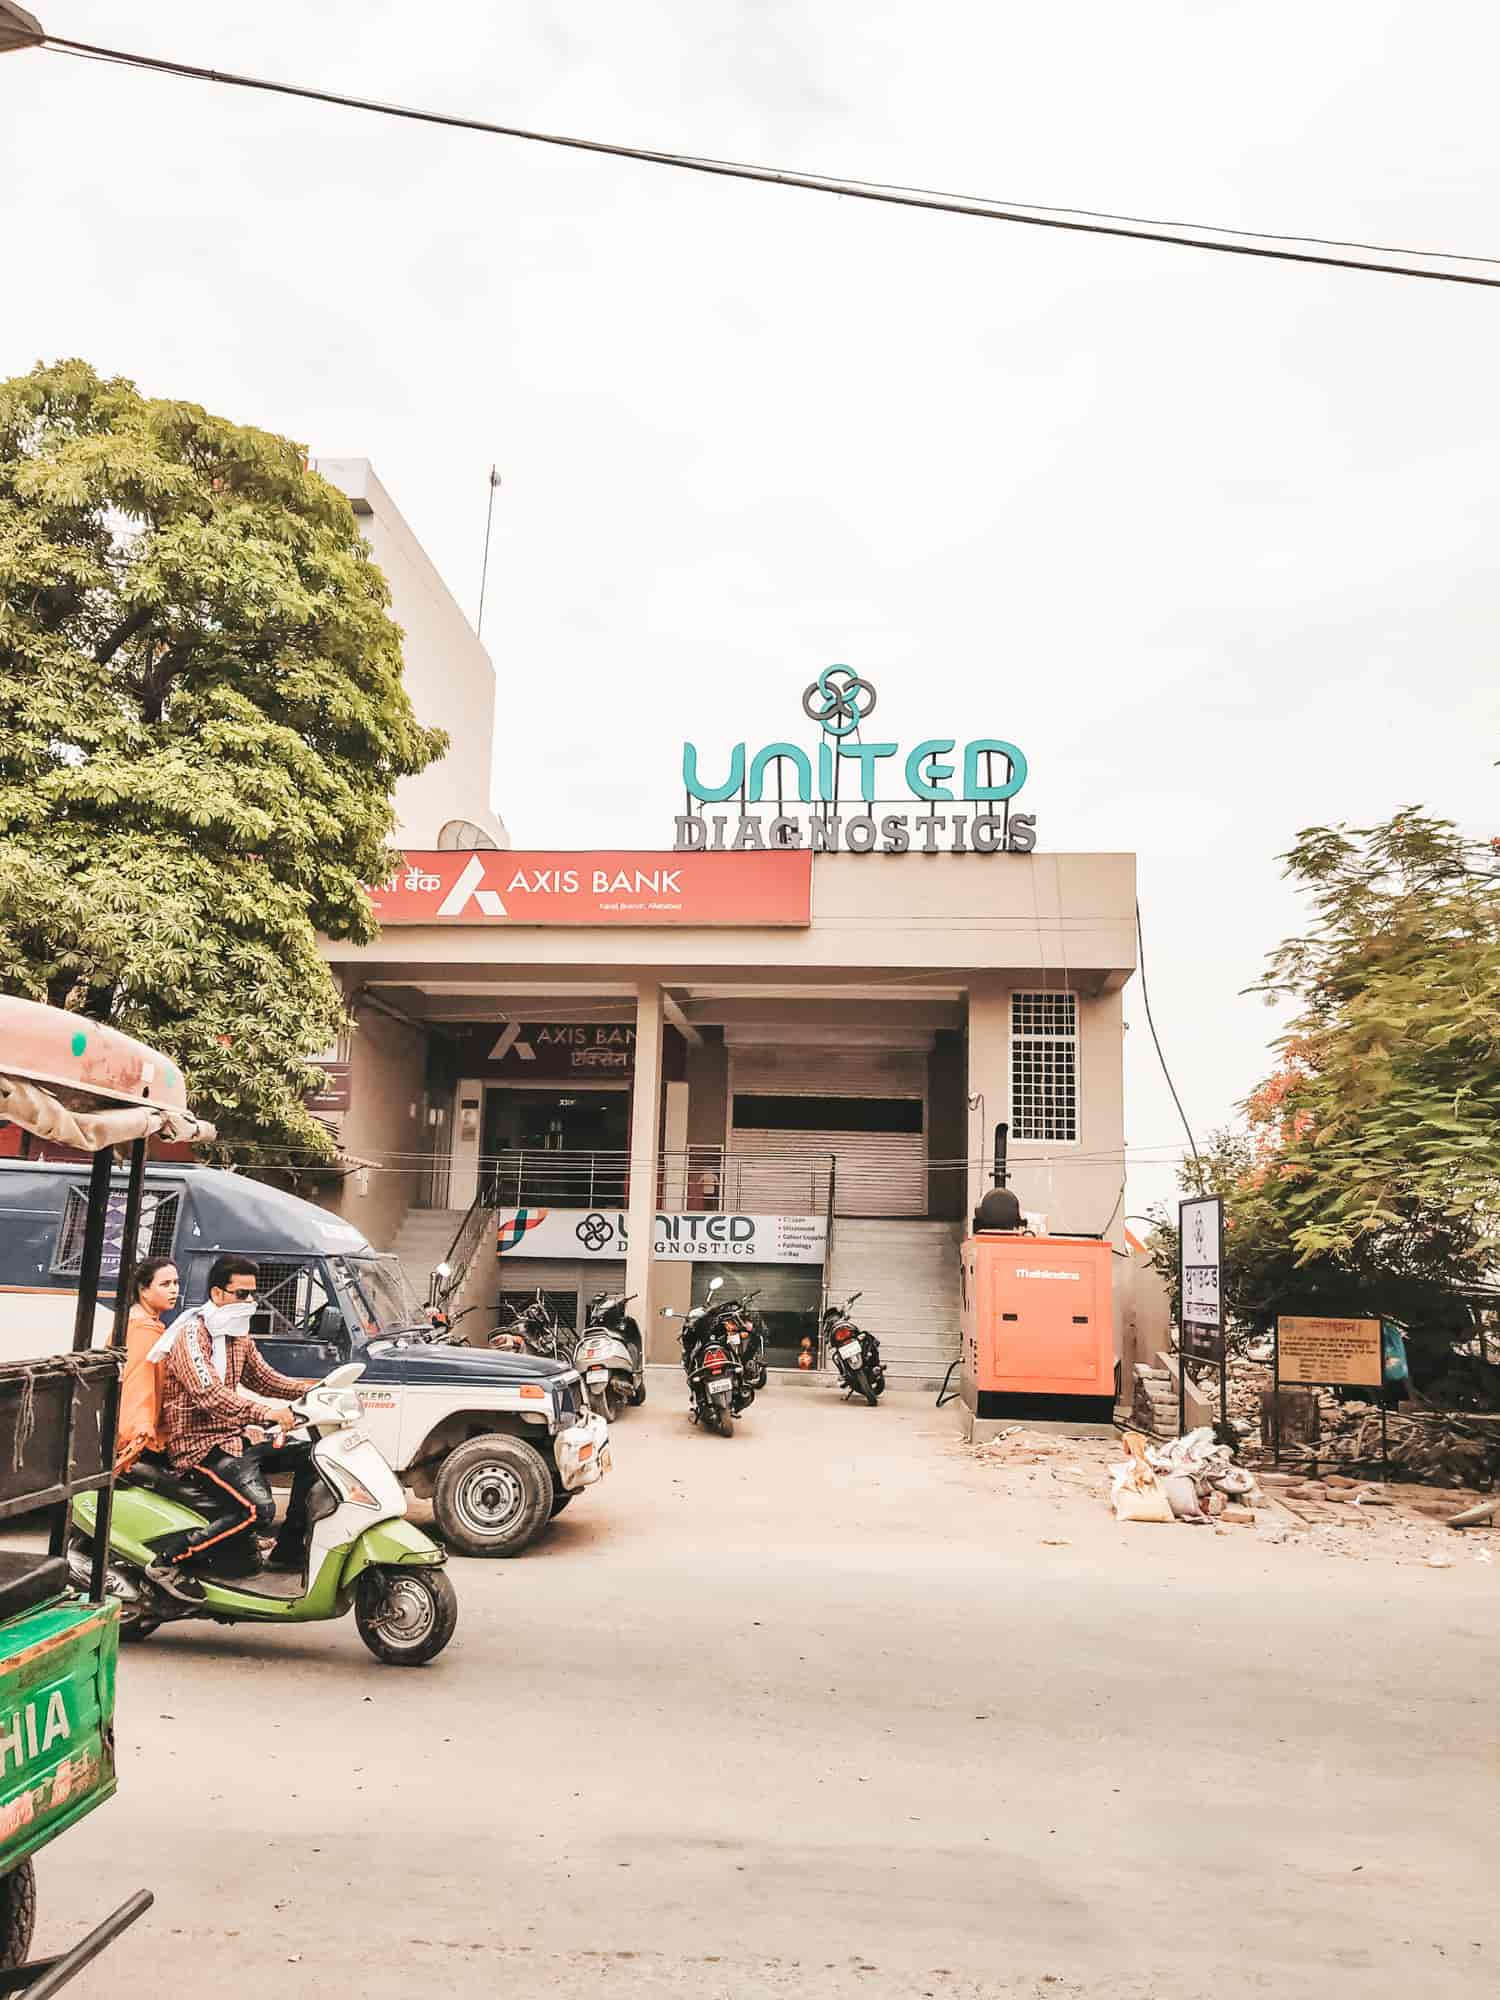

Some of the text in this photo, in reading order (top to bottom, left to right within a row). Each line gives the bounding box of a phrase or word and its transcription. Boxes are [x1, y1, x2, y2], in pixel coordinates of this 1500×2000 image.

[683, 739, 1028, 804] UNITED
[672, 814, 1038, 853] DIAGNOSTICS
[404, 867, 441, 893] बैंक
[507, 870, 684, 893] AXIS BANK
[536, 1027, 637, 1045] AXIS BAN
[616, 1240, 756, 1255] DGNOSTICS
